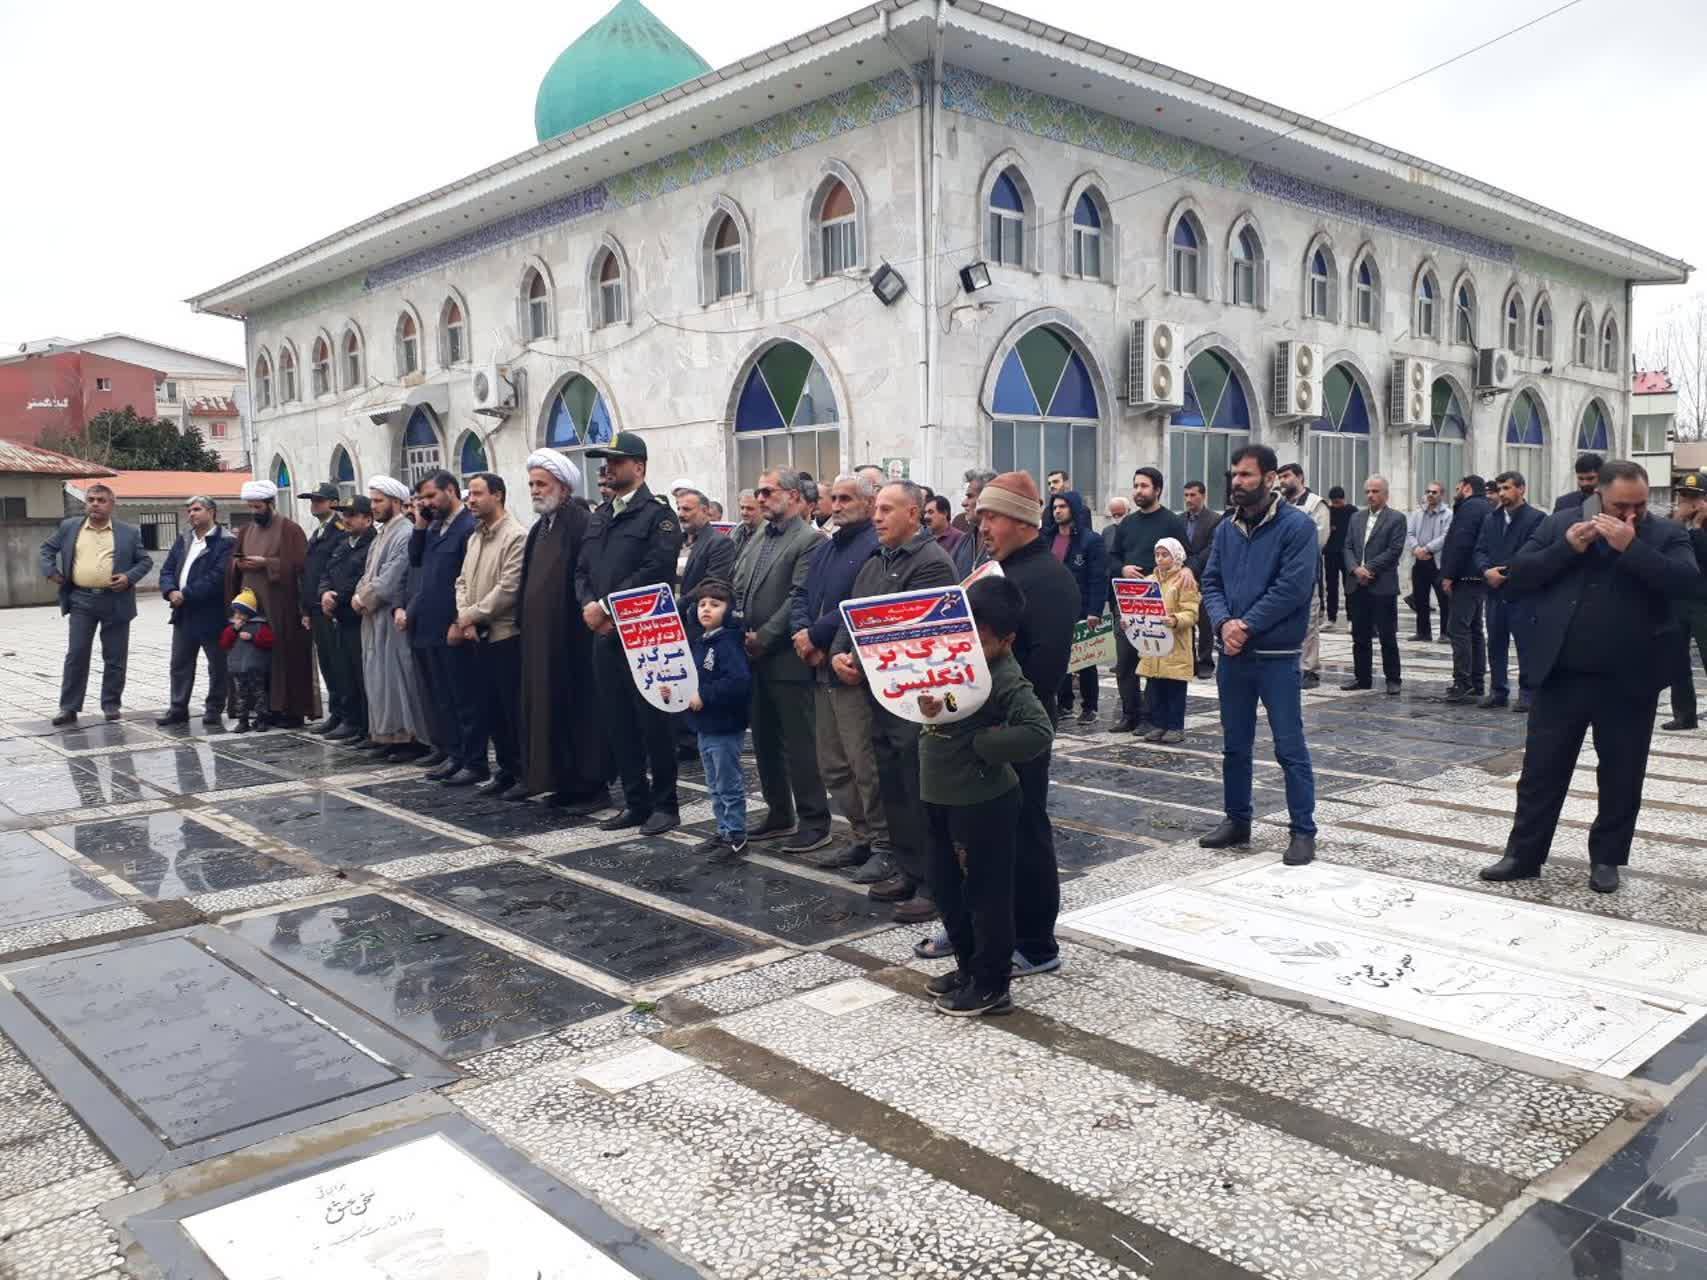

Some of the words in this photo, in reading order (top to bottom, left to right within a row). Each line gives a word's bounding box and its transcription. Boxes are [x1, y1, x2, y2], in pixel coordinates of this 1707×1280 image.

[647, 648, 685, 665] مرگ
[878, 649, 897, 670] بر
[905, 639, 972, 662] مرگ
[644, 671, 654, 690] گر
[656, 664, 688, 682] فتنه
[883, 663, 976, 698] انگلیس
